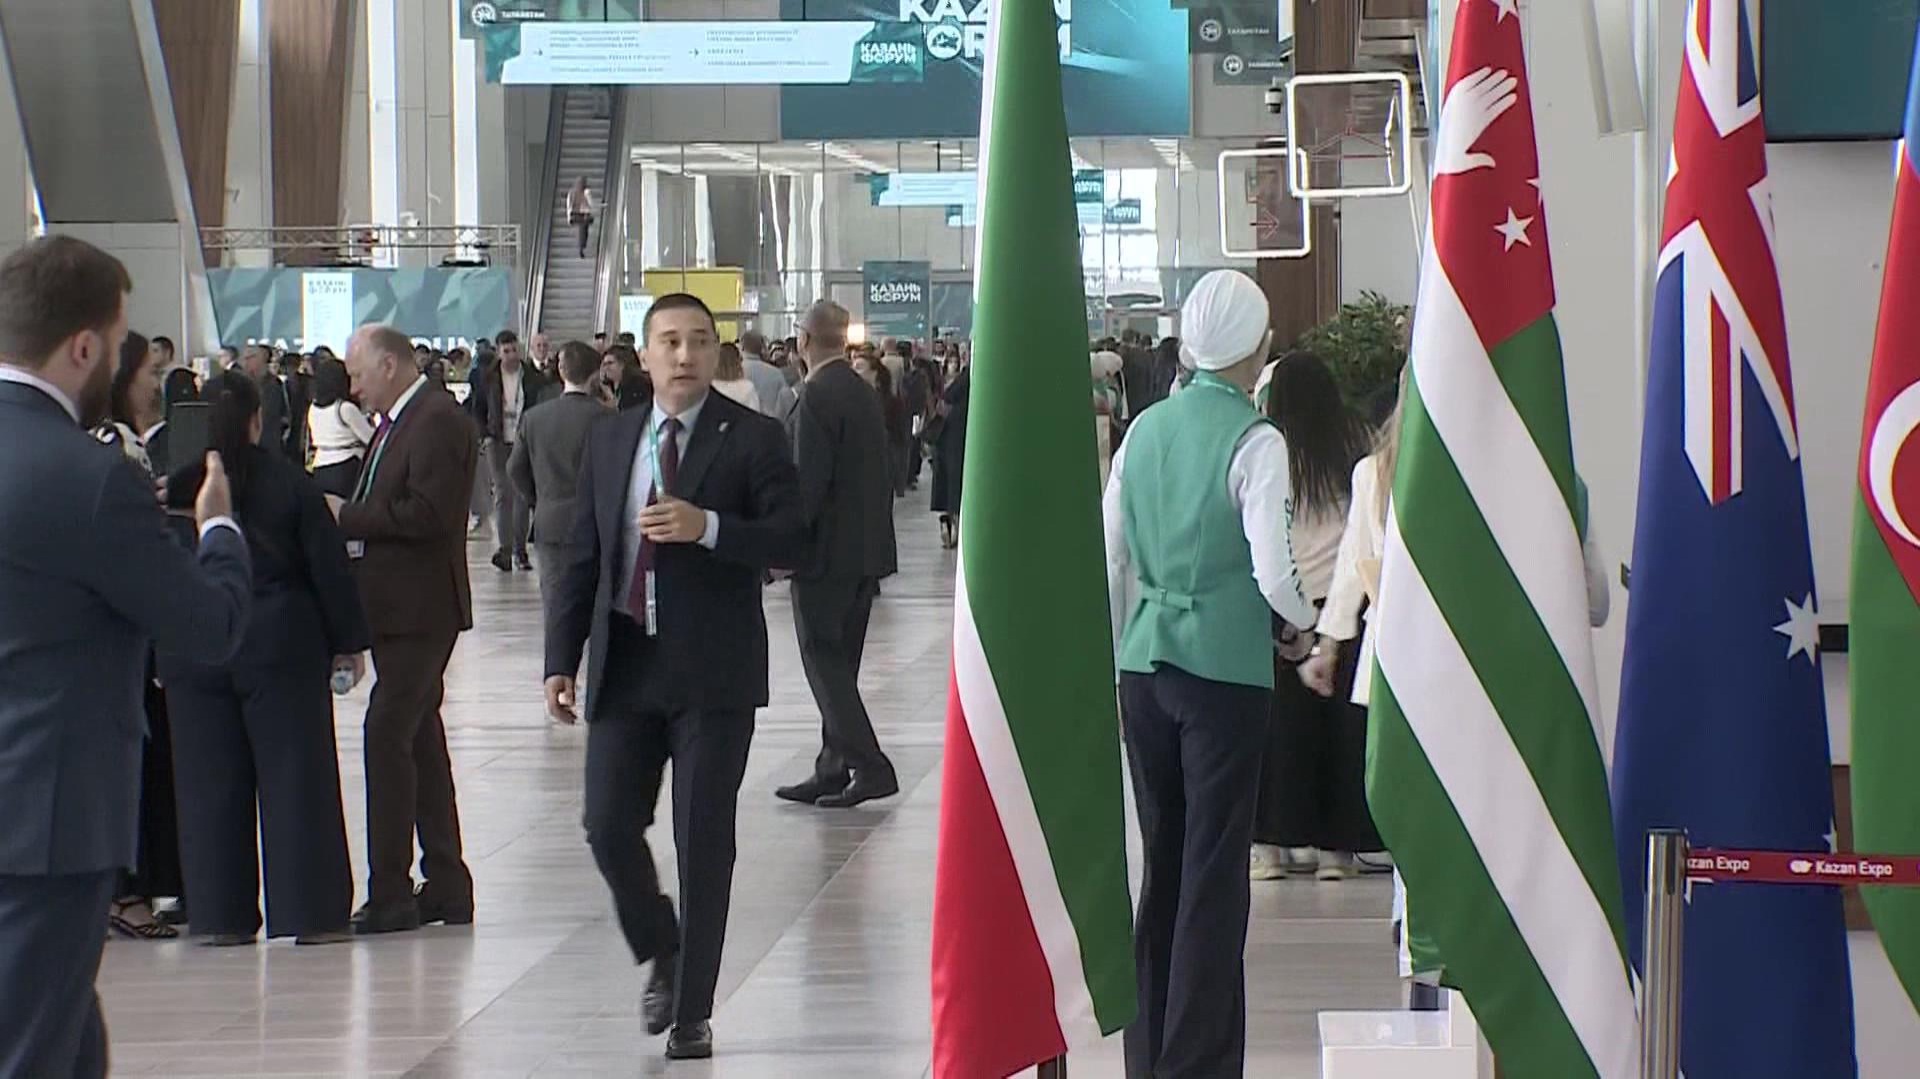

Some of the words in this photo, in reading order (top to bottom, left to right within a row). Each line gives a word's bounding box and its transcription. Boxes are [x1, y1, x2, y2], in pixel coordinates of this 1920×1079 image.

[861, 53, 916, 64] ФОРУМ
[870, 283, 921, 292] КАЗАНЬ
[870, 292, 921, 303] ФОРУМ
[1687, 858, 1714, 869] azan
[1717, 856, 1750, 873] Expo
[1816, 860, 1856, 876] Kazan
[1859, 860, 1893, 879] Expo
